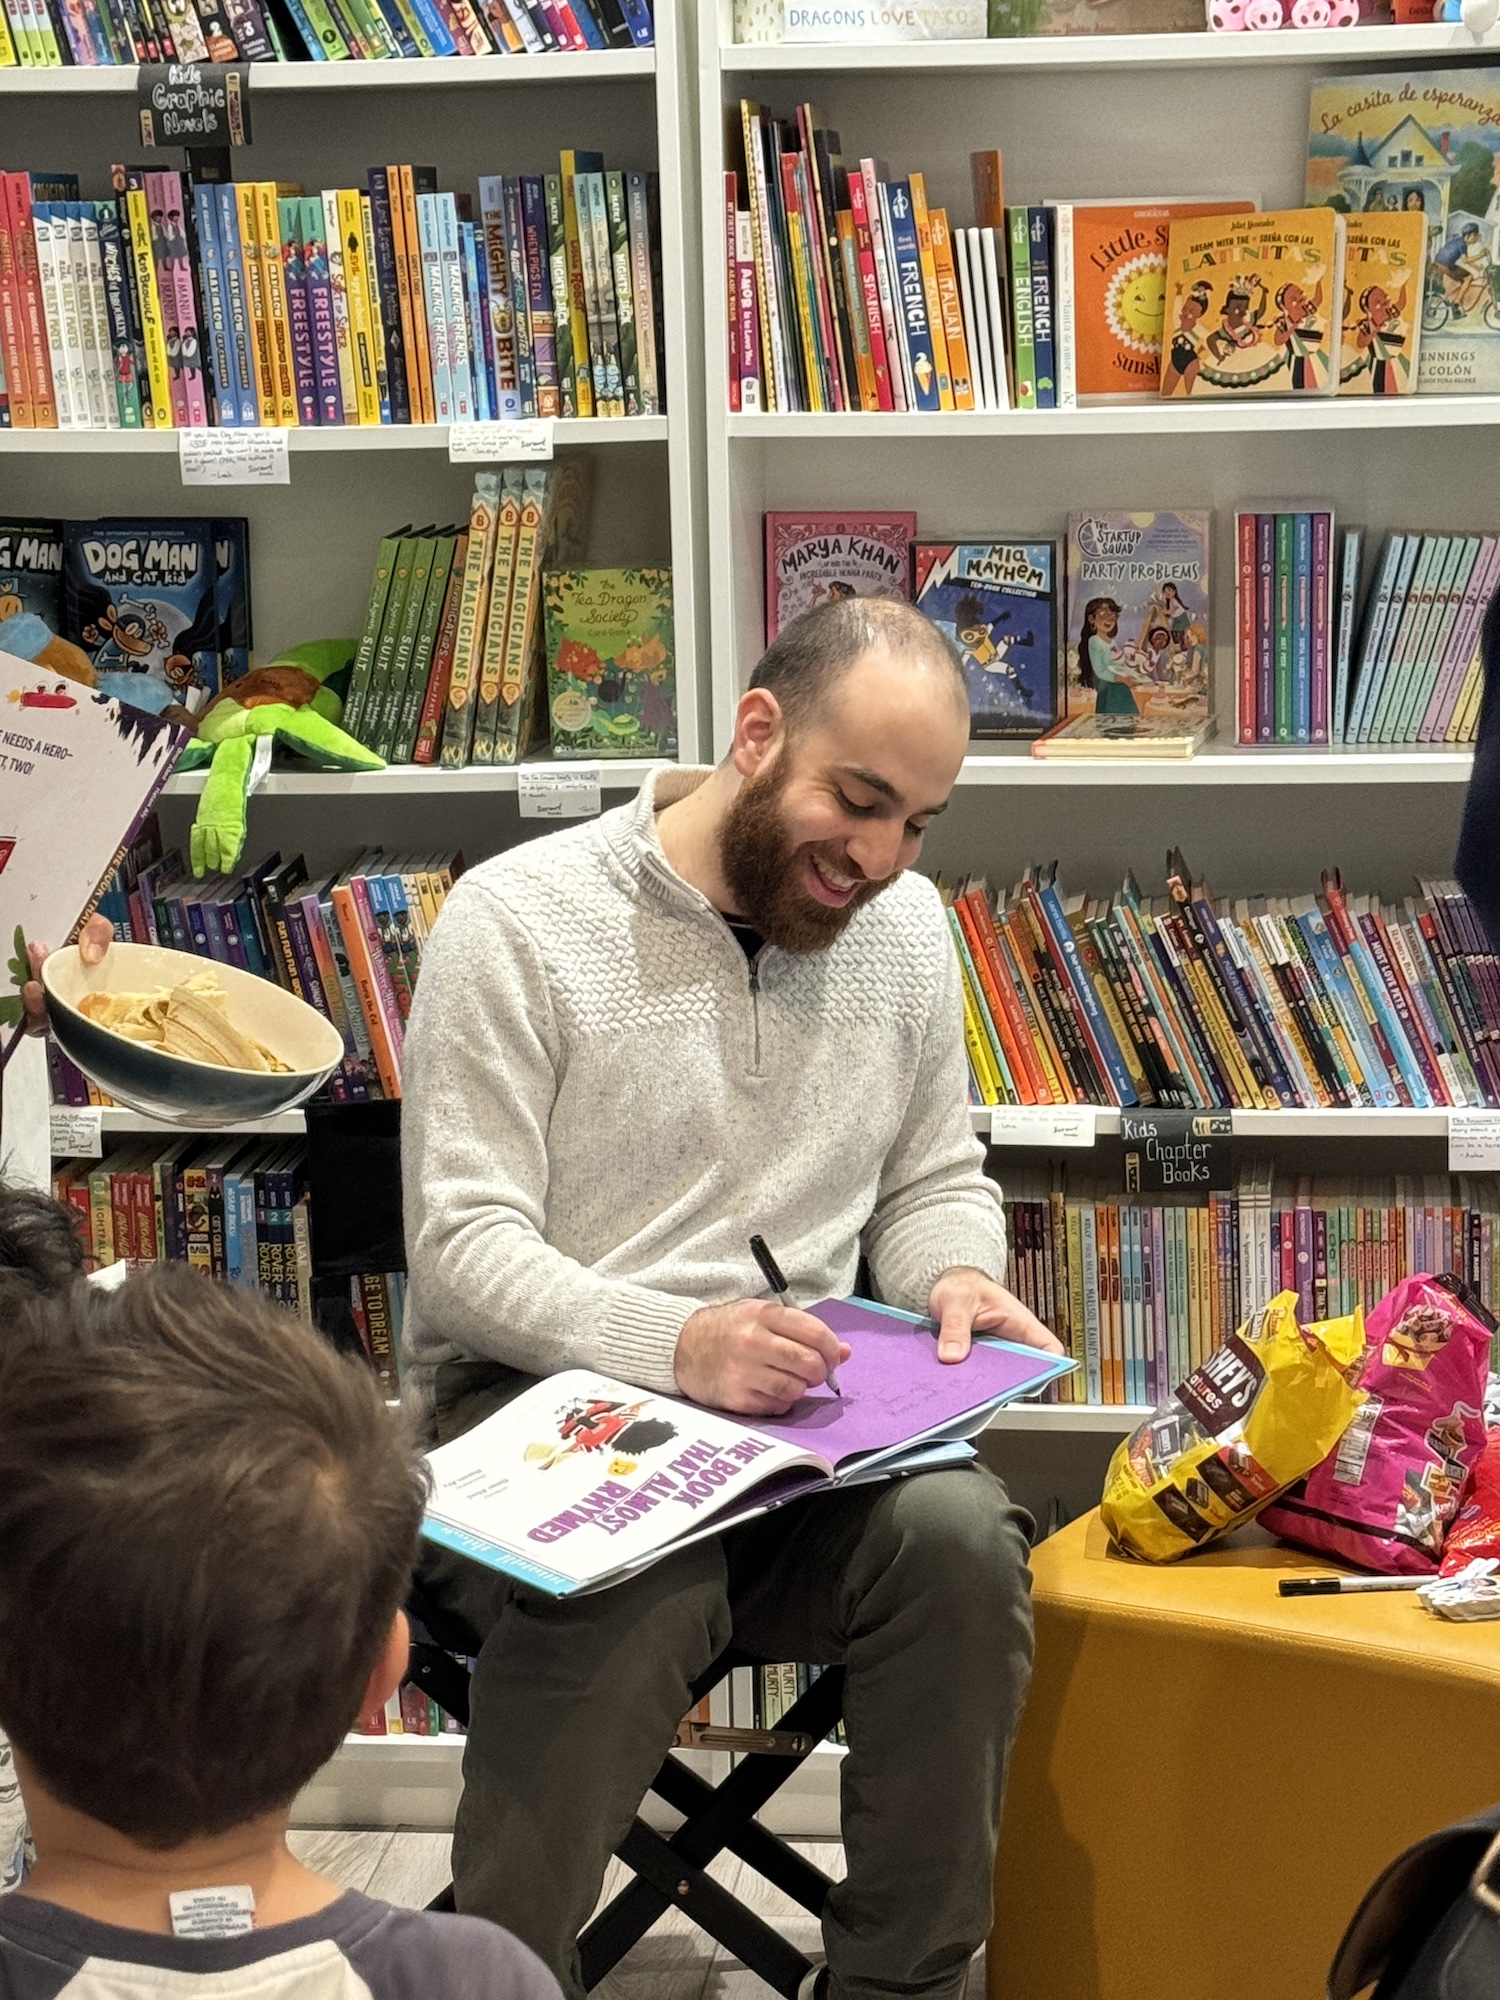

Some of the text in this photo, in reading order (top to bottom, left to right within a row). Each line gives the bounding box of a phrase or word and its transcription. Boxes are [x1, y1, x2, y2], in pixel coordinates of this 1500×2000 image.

[790, 8, 978, 26] DRAGONS LOVE TACOS
[169, 65, 201, 85] Kids
[152, 85, 224, 112] Graphic
[1321, 83, 1417, 134] La casita de
[163, 111, 218, 135] Novels
[726, 214, 734, 235] FIRST
[1190, 232, 1314, 255] DREAM WITH THE SUEÑA CON LAS
[1370, 236, 1400, 248] CON LAS
[526, 224, 542, 301] WHEN PIGS FLY
[611, 194, 631, 324] HATKE MIGHTY JACK
[1089, 228, 1151, 273] Little
[1181, 245, 1322, 273] LATINITAS
[103, 241, 127, 338] WITCHES BROOKLYN
[136, 252, 154, 325] KID BEOWULF
[330, 273, 346, 302] SORT
[553, 255, 565, 295] MIGHTY
[740, 268, 752, 307] AMOR
[207, 268, 223, 330] MAX MEOW
[228, 269, 244, 332] MAX MEOW
[252, 288, 264, 318] MEOW
[427, 264, 447, 366] MAKING FRIENDS
[447, 262, 467, 365] MAKING FRIENDS
[486, 223, 516, 391] MIGHTY BITE
[555, 300, 567, 327] JACK
[863, 274, 882, 334] SPANISH
[901, 261, 927, 336] FRENCH
[924, 276, 941, 330] ITALIAN
[938, 277, 962, 340] ITALIAN
[1016, 277, 1033, 347] ENGLISH
[1034, 276, 1050, 343] FRENCH
[289, 287, 314, 388] FREESTYLE
[312, 287, 337, 387] FREESTYLE
[335, 316, 351, 348] SUPER
[515, 310, 528, 357] MONSTER
[1436, 364, 1472, 376] COLÓN
[16, 538, 64, 571] MAN
[781, 536, 900, 576] MARYA KHAN
[1097, 530, 1141, 544] STARTUP
[1102, 543, 1134, 555] SQUAD
[82, 540, 139, 574] DOG
[144, 540, 197, 571] MAN
[801, 569, 882, 581] INCREDIBLE HENNA PARTY
[1083, 562, 1200, 580] PARTY PROBLEMS
[133, 572, 157, 583] CAT
[600, 578, 616, 590] The
[1001, 584, 1037, 598] COLLECTION
[367, 601, 379, 630] Agents
[388, 600, 400, 629] Agents
[405, 600, 418, 629] Agents
[424, 600, 436, 628] Agents
[454, 539, 484, 680] THE MAGICIANS
[486, 536, 512, 675] THE MAGICIANS
[507, 536, 534, 677] THE MAGICIANS
[572, 591, 647, 610] Tea Dragon
[580, 609, 638, 627] Society
[2, 731, 35, 751] NEEDS
[33, 741, 41, 753] A
[9, 758, 35, 775] TWO!
[95, 845, 129, 902] THE BOOK
[273, 919, 301, 977] FUN FUN FUN
[1250, 945, 1289, 1013] MUST LOVE PETS
[1369, 939, 1407, 1009] MUST LOVE PETS
[341, 982, 370, 1044] Lo Behold
[1121, 1117, 1158, 1140] Kids
[1146, 1132, 1212, 1167] Chapter
[1162, 1162, 1210, 1184] Books
[270, 1212, 278, 1221] 2
[284, 1212, 292, 1221] 2
[257, 1242, 271, 1280] ROVER
[294, 1217, 308, 1267] BOLIVAR
[270, 1243, 284, 1282] ROVER
[284, 1243, 297, 1282] ROVER
[367, 1294, 383, 1310] TO
[1083, 1218, 1098, 1357] KELLY MARISOL RAINEY
[369, 1312, 389, 1354] DREAM
[598, 1438, 724, 1536] THAT ALMOST
[672, 1437, 777, 1510] THE BOOK
[526, 1480, 631, 1543] RHYMED
[766, 1664, 779, 1697] MURTY
[783, 1664, 795, 1697] MURTY
